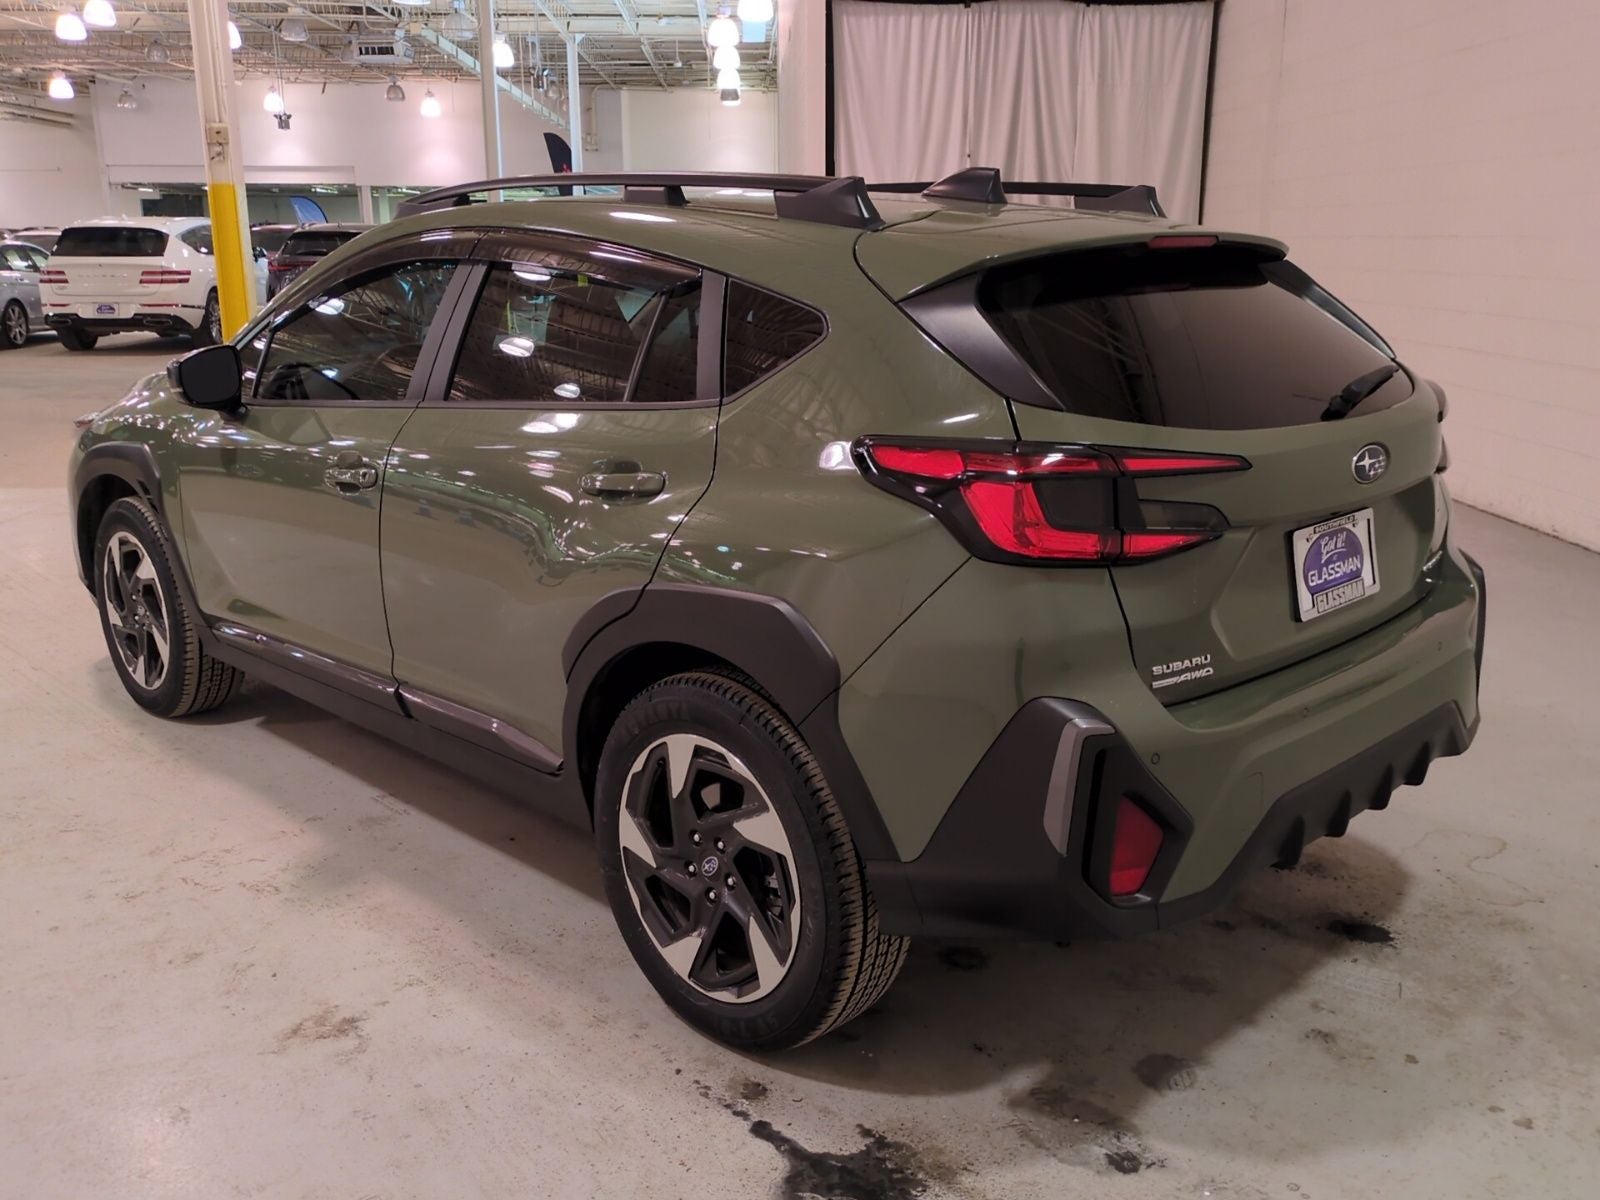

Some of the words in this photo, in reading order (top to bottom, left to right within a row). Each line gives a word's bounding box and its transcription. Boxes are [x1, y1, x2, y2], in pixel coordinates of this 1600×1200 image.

[1308, 554, 1361, 586] GLASSMAN
[1152, 654, 1211, 675] SUBARU
[1177, 667, 1214, 683] AWD
